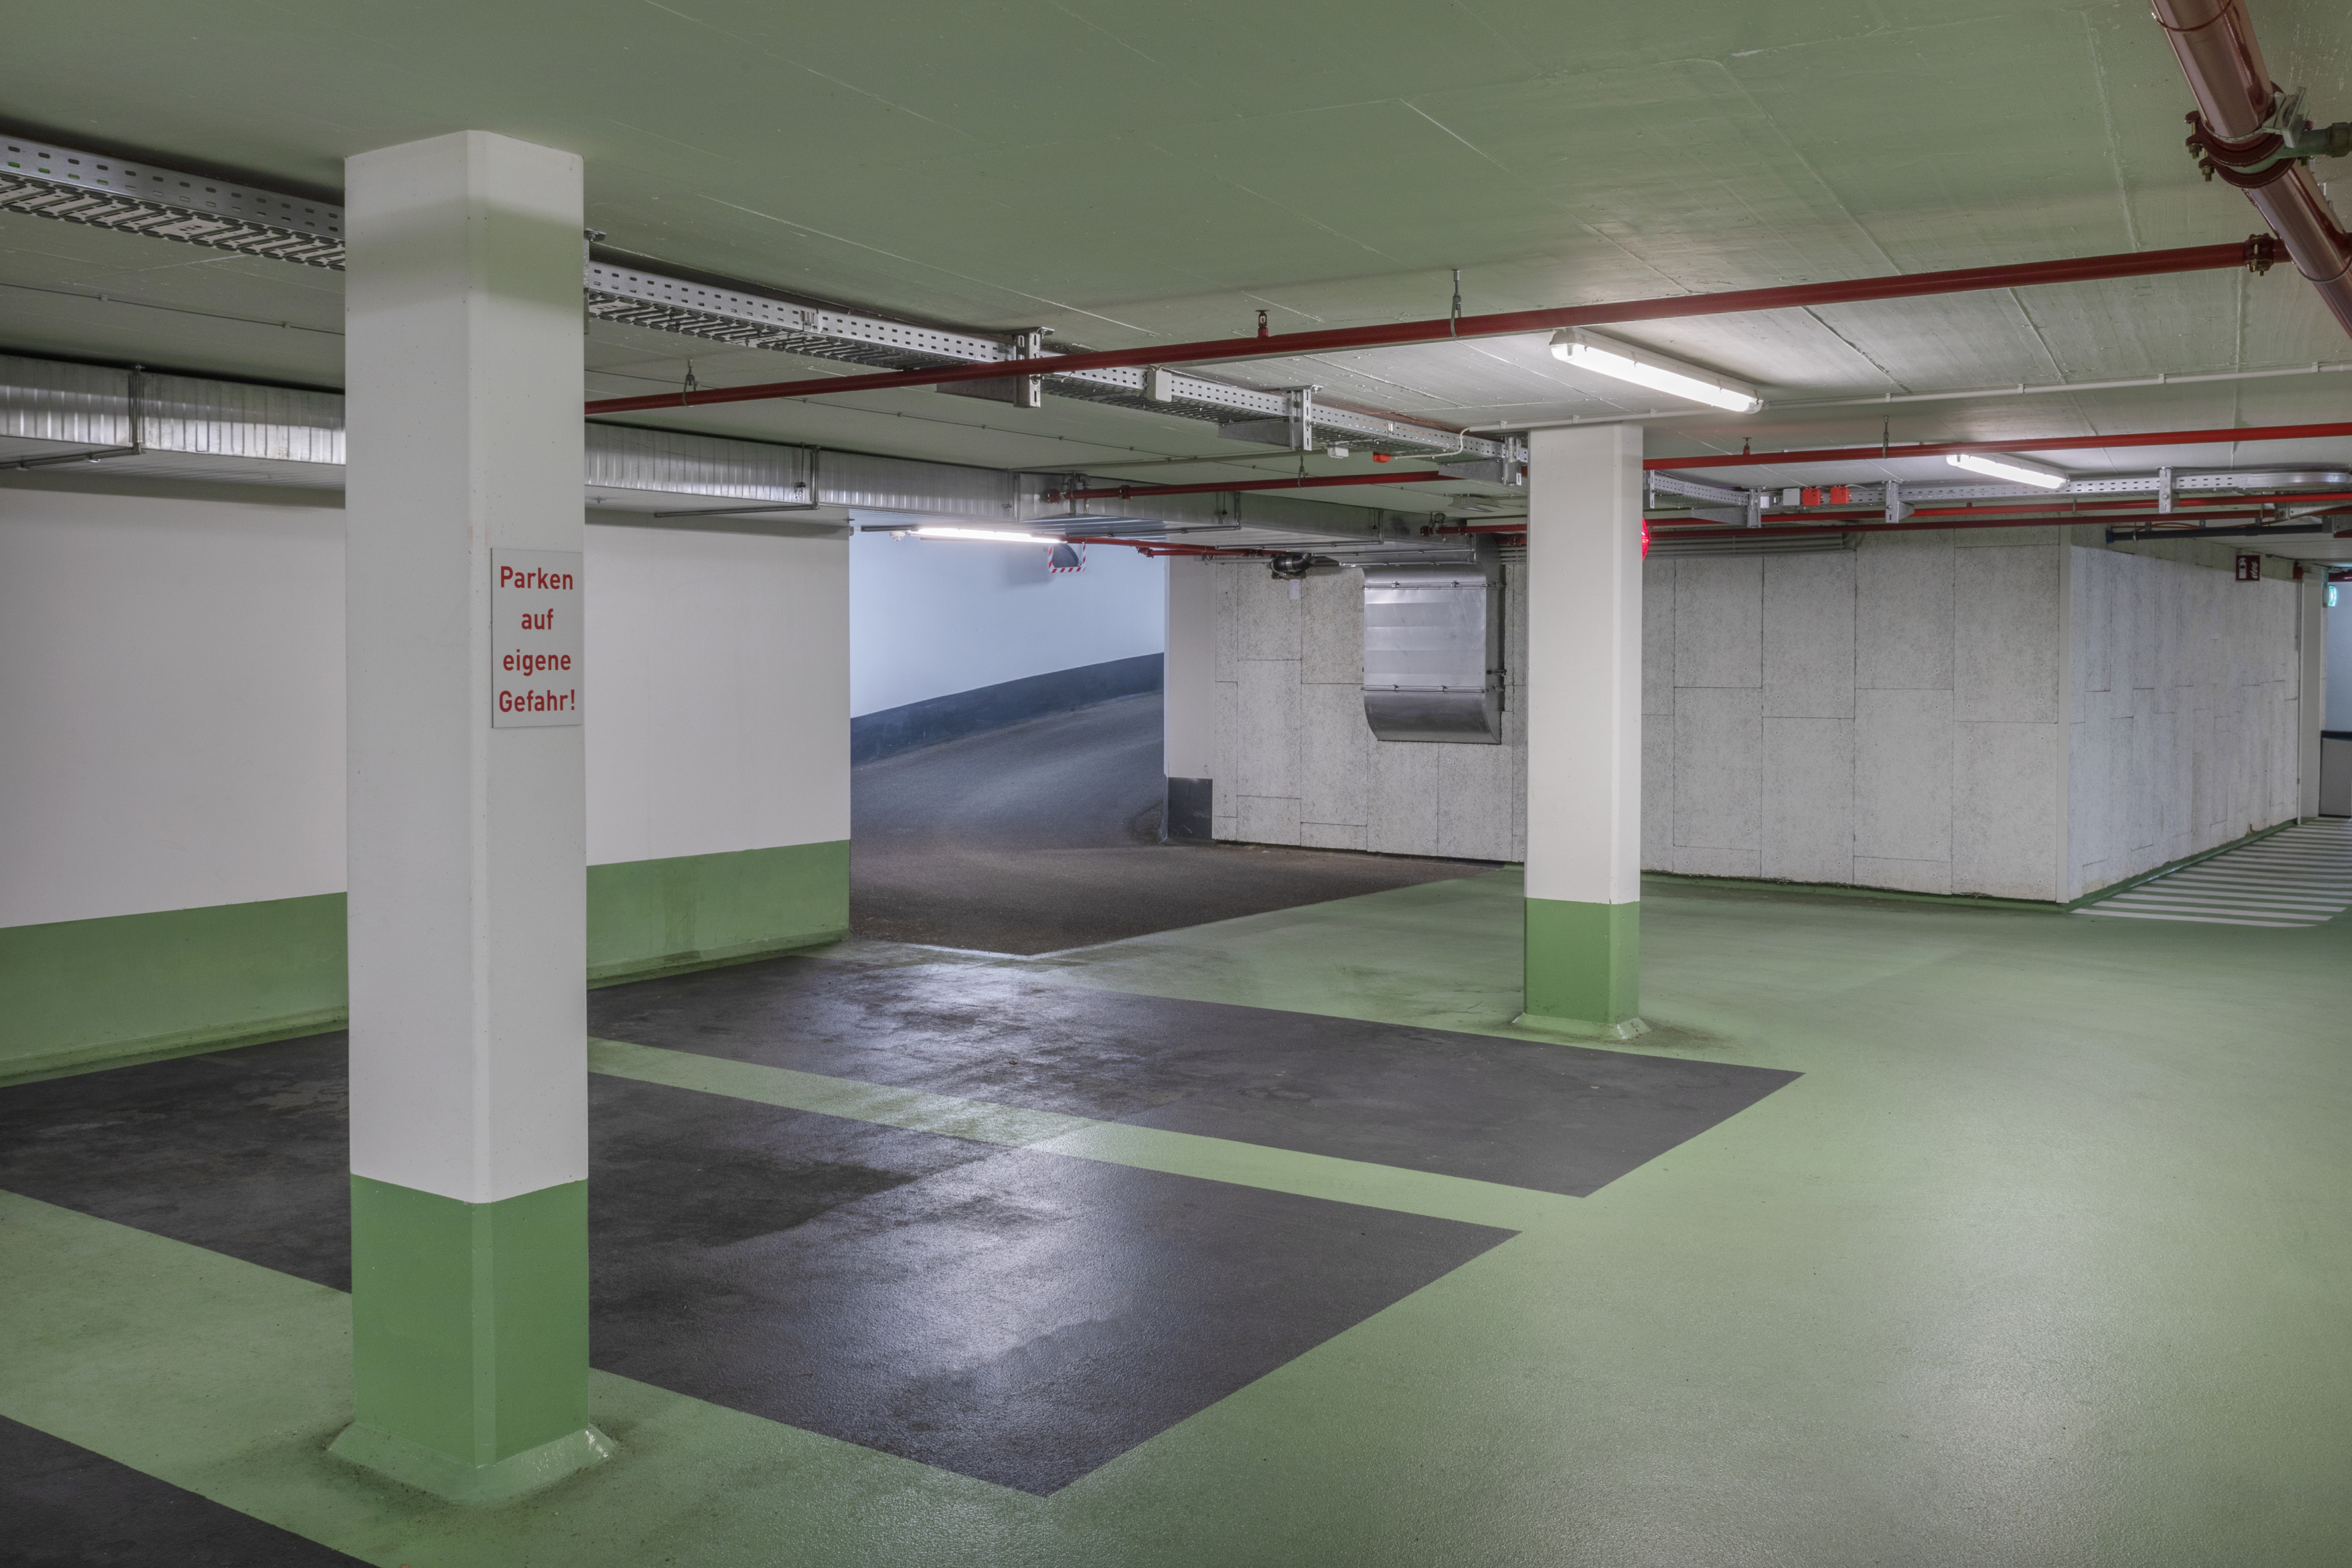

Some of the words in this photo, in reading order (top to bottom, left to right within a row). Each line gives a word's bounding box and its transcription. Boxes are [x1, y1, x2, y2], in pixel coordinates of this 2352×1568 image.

[501, 566, 573, 590] Parken
[521, 608, 554, 630] auf
[503, 649, 571, 676] eigene
[499, 689, 575, 712] Gefahr!
